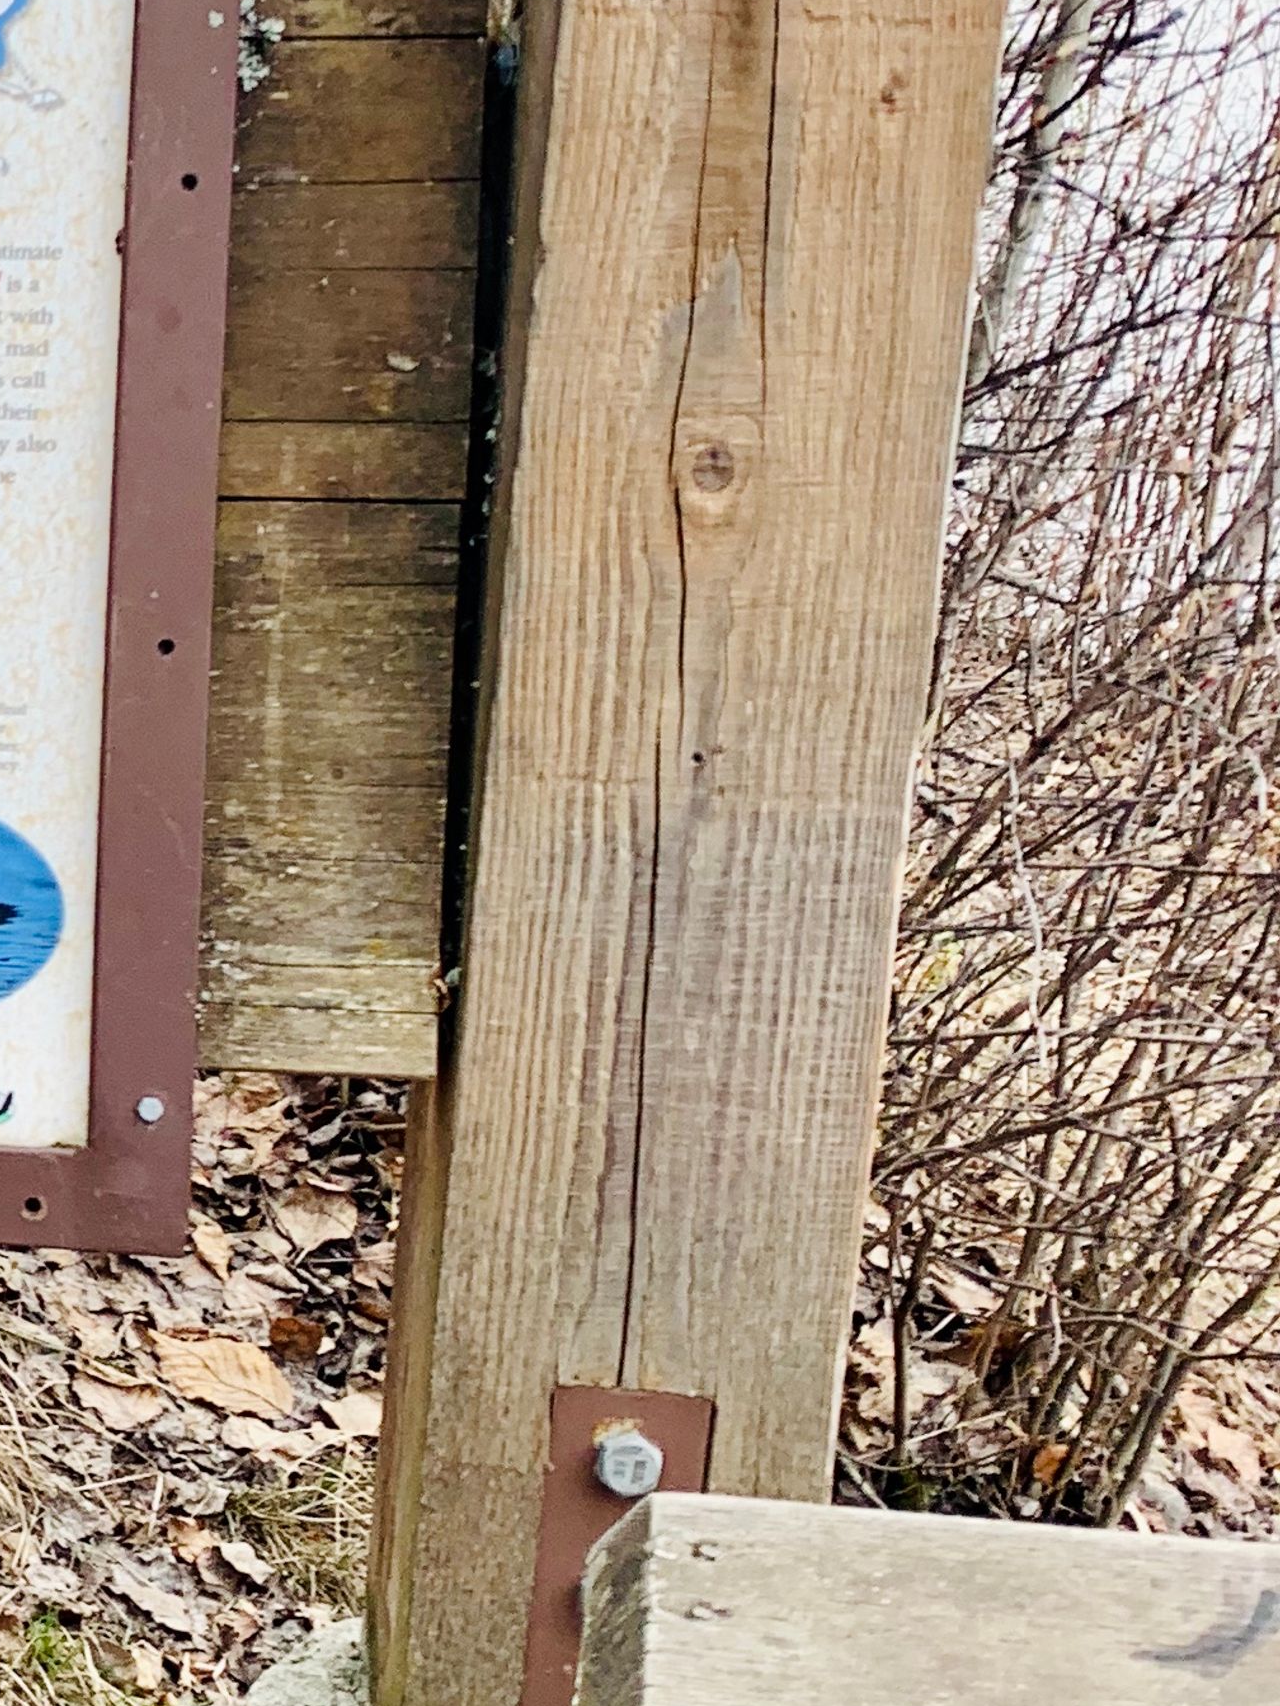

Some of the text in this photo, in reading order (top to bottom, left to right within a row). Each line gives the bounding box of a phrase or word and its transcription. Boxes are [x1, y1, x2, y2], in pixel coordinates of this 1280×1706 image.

[7, 276, 22, 292] is
[29, 280, 40, 292] a
[8, 308, 53, 325] with
[6, 340, 49, 358] mad
[12, 371, 45, 388] call
[16, 435, 56, 452] also
